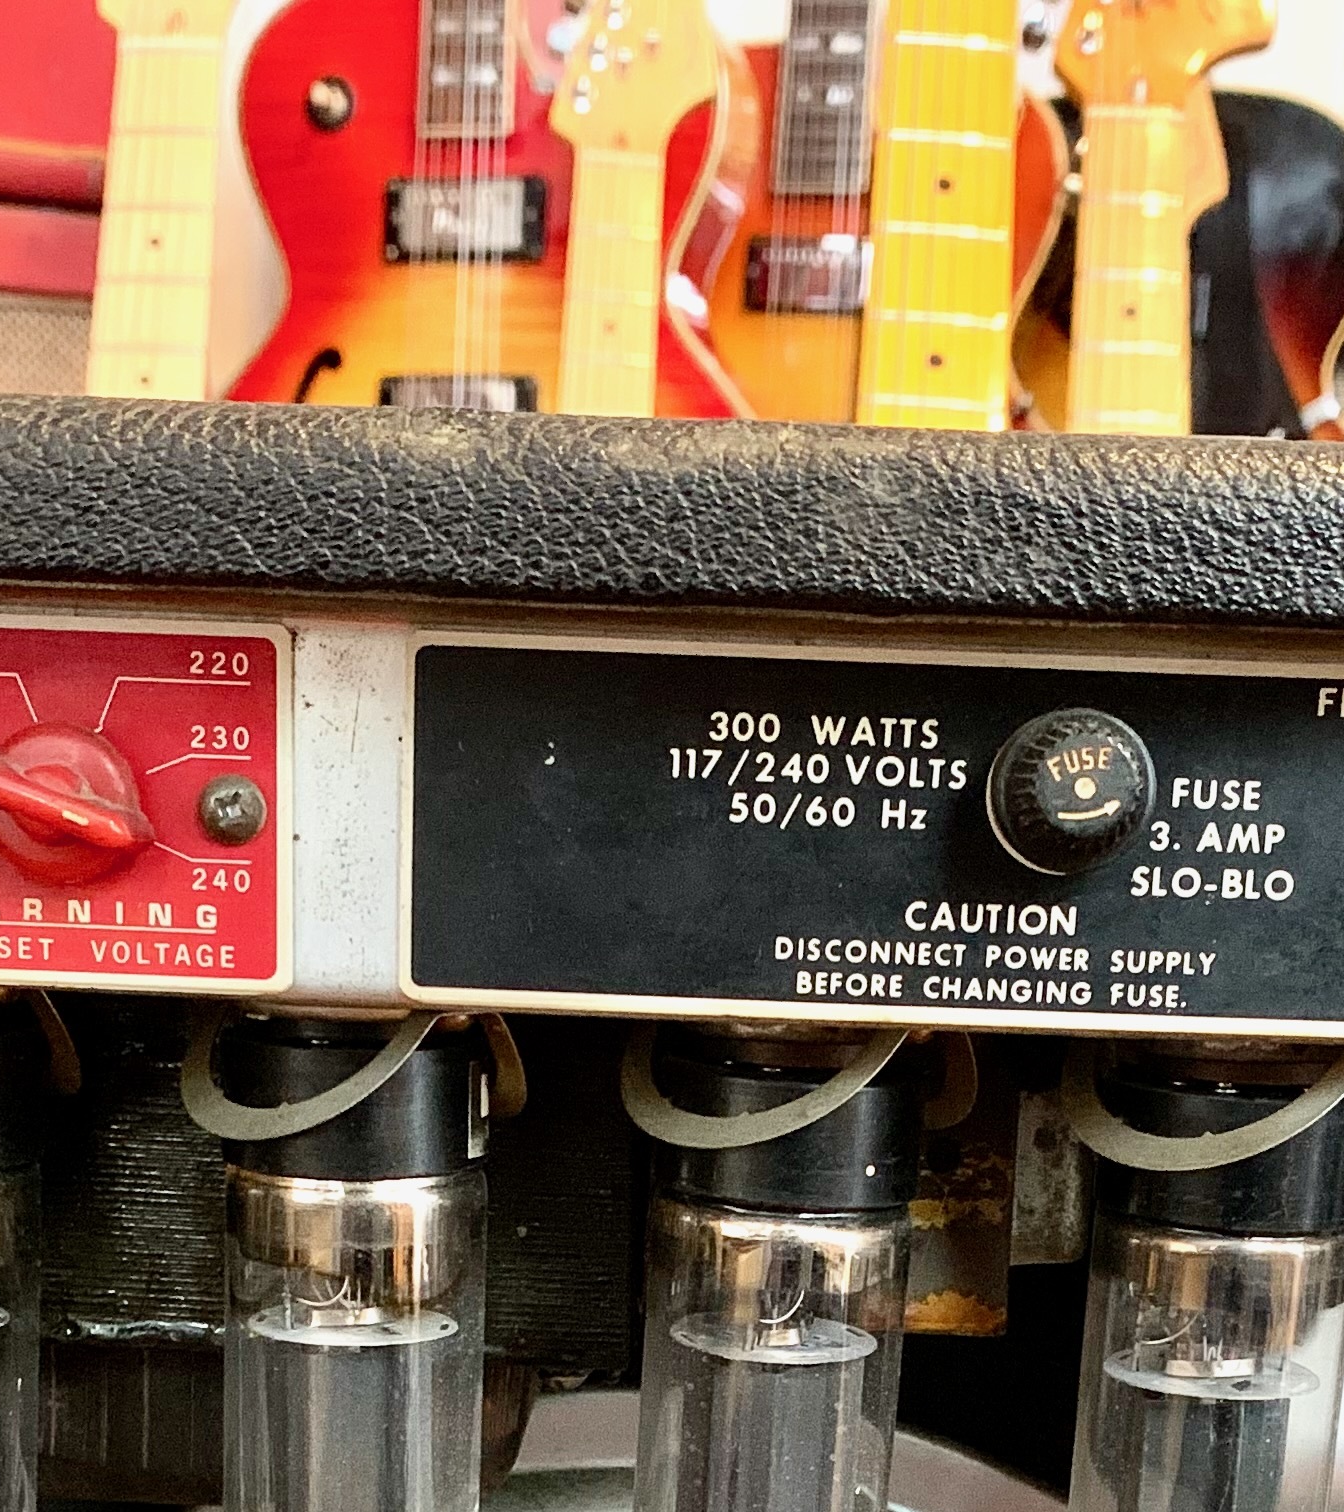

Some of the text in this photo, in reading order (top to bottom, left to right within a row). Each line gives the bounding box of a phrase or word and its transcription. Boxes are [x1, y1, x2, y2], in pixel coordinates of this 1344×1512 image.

[190, 651, 248, 675] 220
[191, 725, 249, 750] 230
[709, 711, 938, 749] 300 WATTS
[670, 748, 967, 789] 117/240 VOLTS
[1047, 747, 1112, 781] FUSE
[729, 793, 927, 829] 50/60 Hz
[1172, 778, 1261, 810] FUSE
[1196, 822, 1285, 854] AMP
[192, 868, 250, 892] 240
[1131, 866, 1294, 900] SLO-BLO
[905, 901, 1077, 935] CAUTION
[91, 940, 234, 968] VOLTAGE
[775, 937, 1216, 975] DISCONNECT POWER SUPPLY
[797, 971, 1186, 1008] BEFORE CHANGING FUSE.
